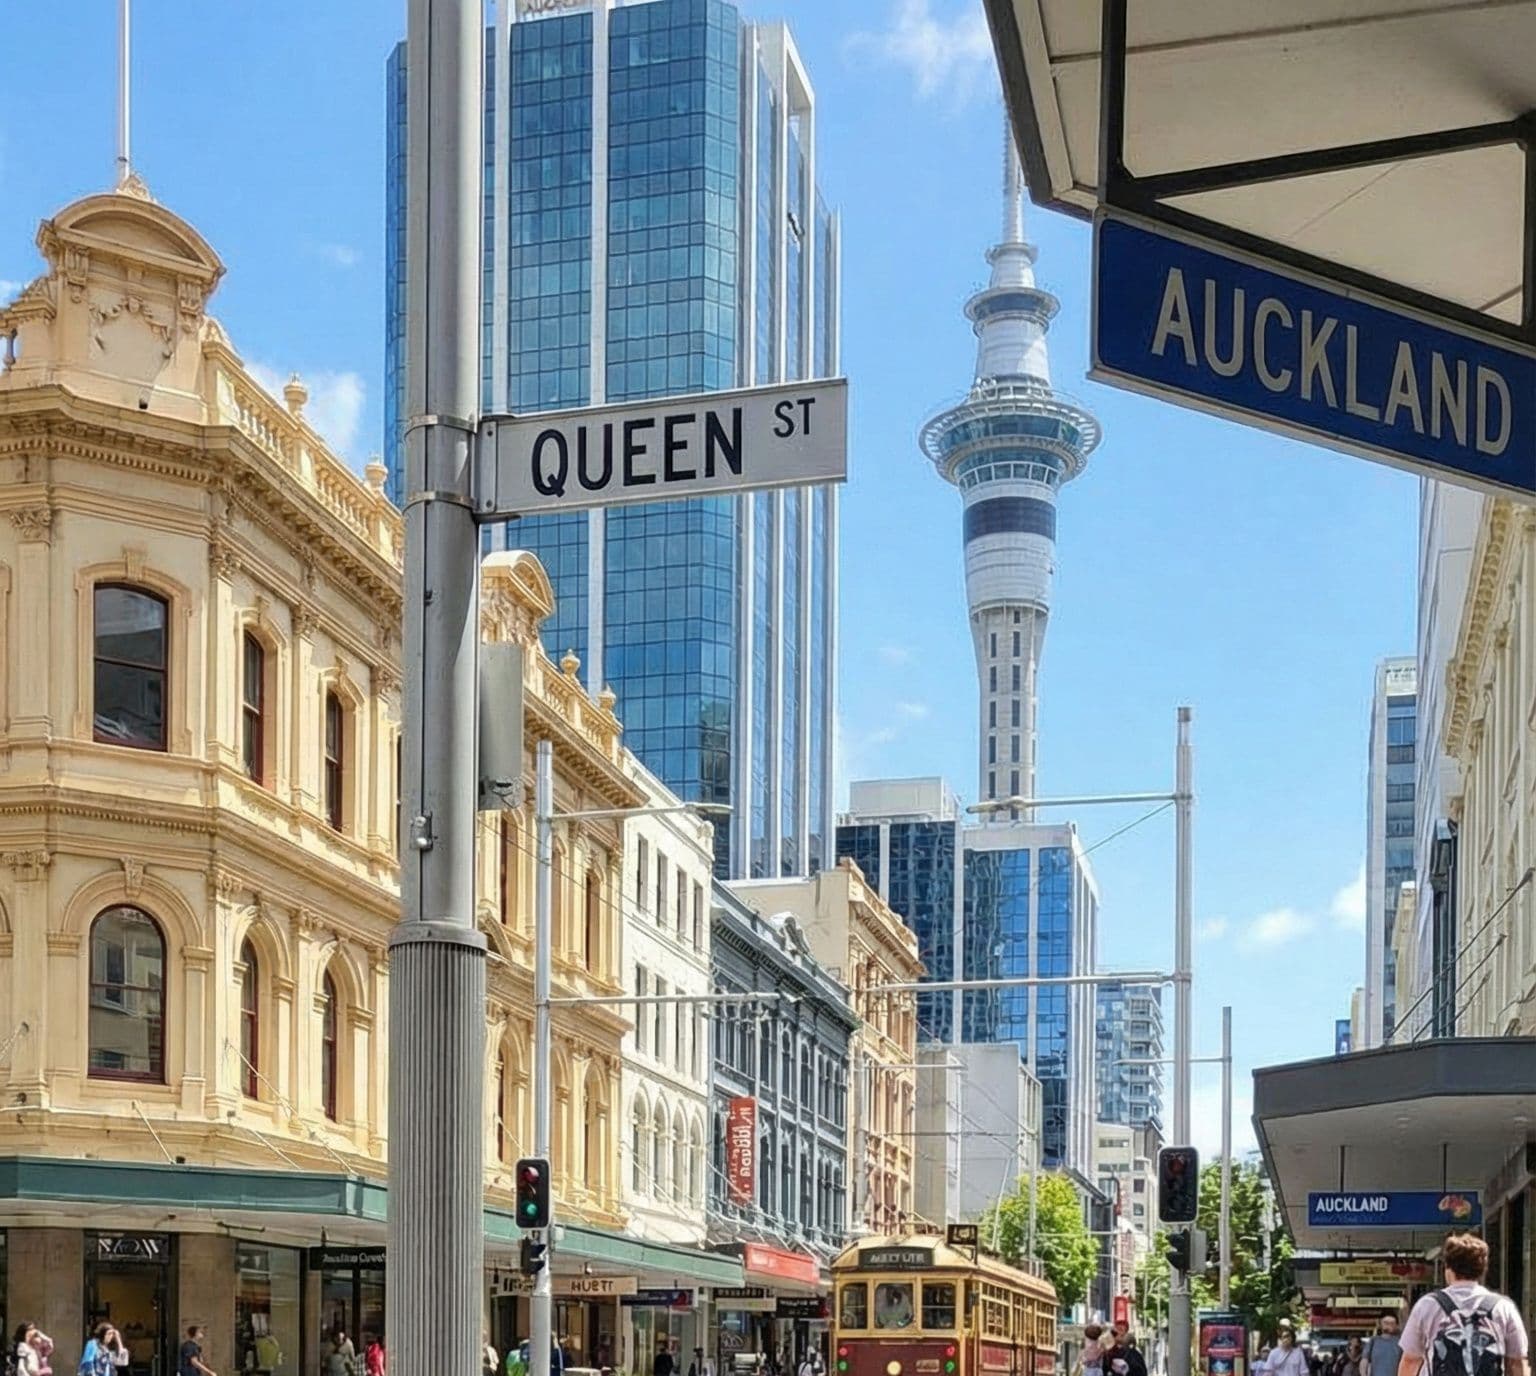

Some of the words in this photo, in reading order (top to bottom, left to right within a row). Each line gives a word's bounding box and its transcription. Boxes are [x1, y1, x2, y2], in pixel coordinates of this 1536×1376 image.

[1151, 266, 1513, 457] AUCKLAND
[531, 406, 744, 497] QUEEN
[772, 397, 816, 438] ST
[1315, 1196, 1388, 1213] AUCKLAND
